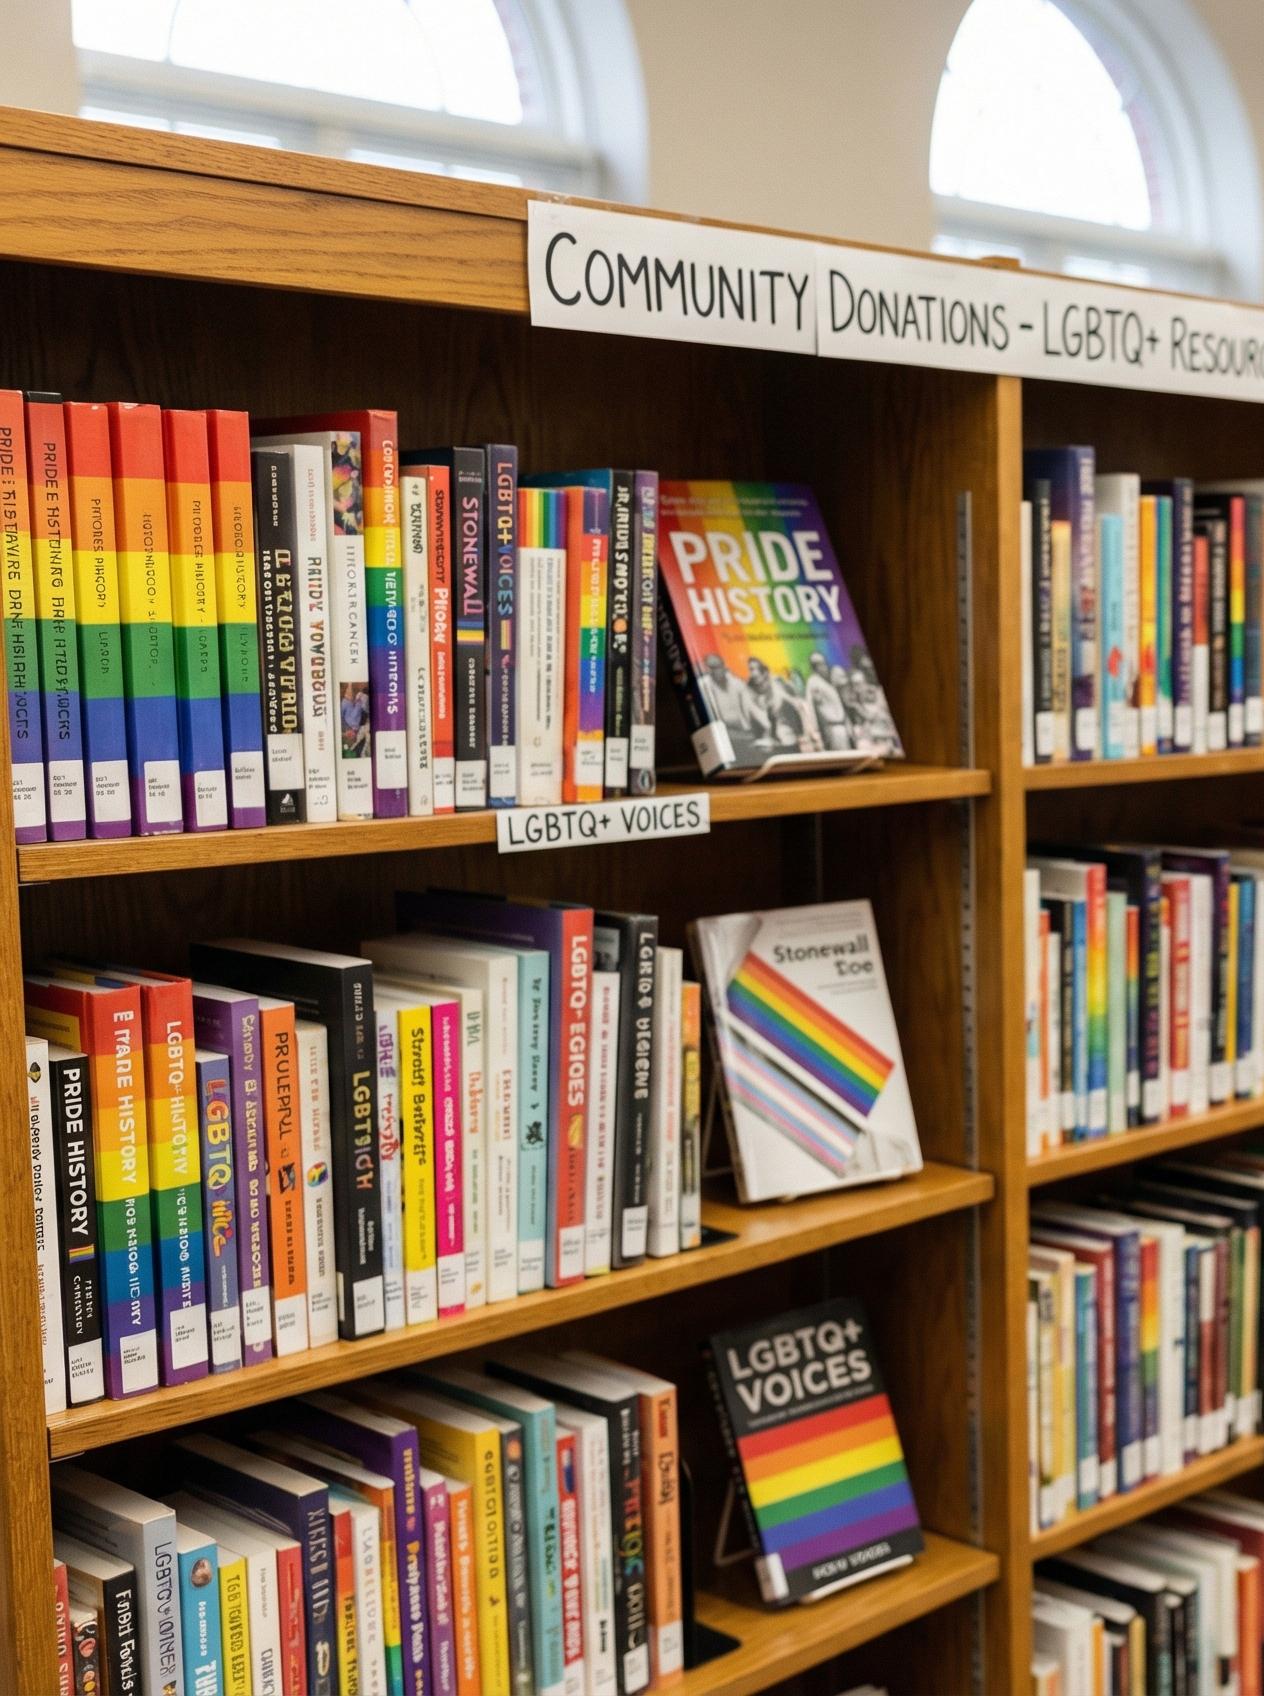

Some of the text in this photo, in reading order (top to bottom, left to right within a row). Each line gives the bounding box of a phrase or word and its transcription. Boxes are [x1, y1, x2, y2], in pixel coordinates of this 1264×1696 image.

[545, 232, 810, 332] COMMUNITY
[830, 269, 1010, 352] DONATIONS
[1044, 299, 1160, 366] LGBTQ+
[668, 530, 834, 584] PRIDE
[687, 585, 842, 626] HISTORY
[508, 801, 700, 846] LGBTQ+ VOICES
[773, 933, 870, 963] Stonewall
[63, 1068, 89, 1236] PRIDE HISTORY
[118, 1095, 137, 1184] HISTORY
[727, 1318, 862, 1380] LGBTQ+
[736, 1349, 872, 1414] VOICES
